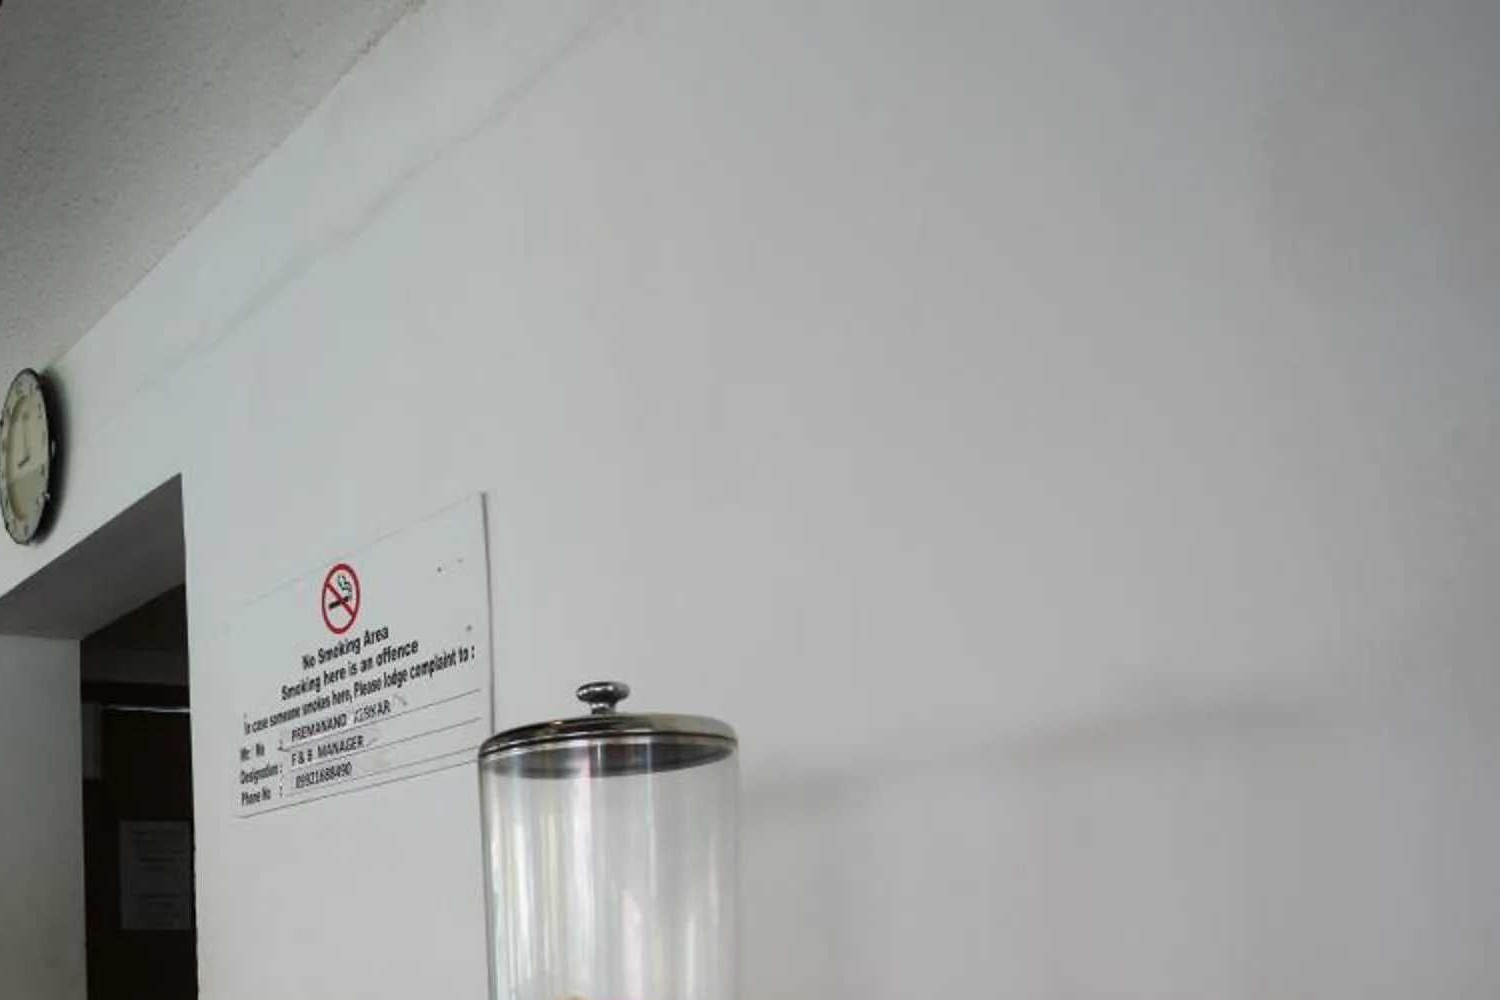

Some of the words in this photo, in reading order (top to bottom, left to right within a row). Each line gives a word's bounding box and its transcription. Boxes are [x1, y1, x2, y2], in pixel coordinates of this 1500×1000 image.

[302, 653, 316, 670] No
[318, 636, 361, 664] Smoking
[363, 626, 389, 645] Area
[281, 675, 320, 701] Smoking
[324, 666, 347, 685] here
[349, 660, 358, 677] is
[360, 657, 374, 673] an
[376, 640, 419, 668] offence
[251, 715, 269, 733] case
[269, 705, 301, 727] someone
[302, 695, 330, 717] smokes
[353, 676, 382, 700] Please
[383, 667, 409, 689] lodge
[409, 648, 457, 679] complaint
[458, 646, 469, 664] to
[291, 713, 348, 742] PREMANAND
[317, 734, 365, 759] MANAGER
[240, 790, 261, 807] Phone
